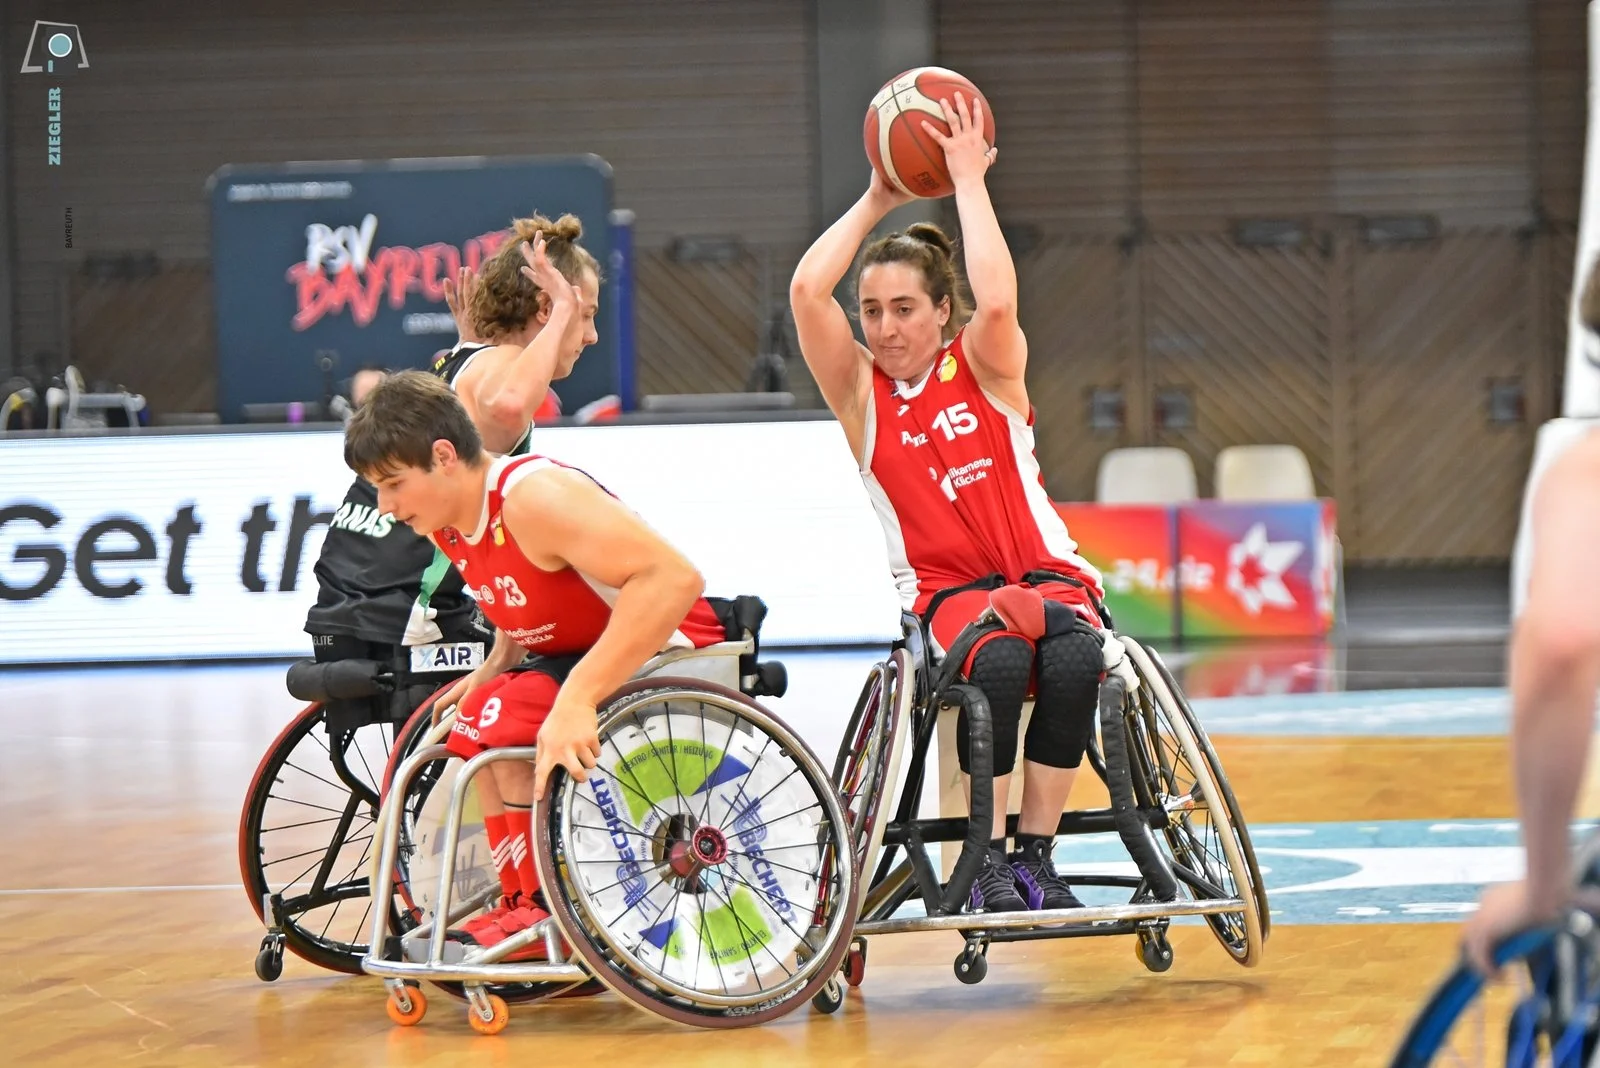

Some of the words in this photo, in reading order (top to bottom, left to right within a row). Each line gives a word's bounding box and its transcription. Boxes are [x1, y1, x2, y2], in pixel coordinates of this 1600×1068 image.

[932, 402, 978, 441] 15
[0, 503, 203, 601] Get
[452, 720, 480, 741] REND
[620, 752, 648, 775] EEKTRO
[651, 745, 678, 758] SANITR
[589, 777, 642, 876] BECHERT
